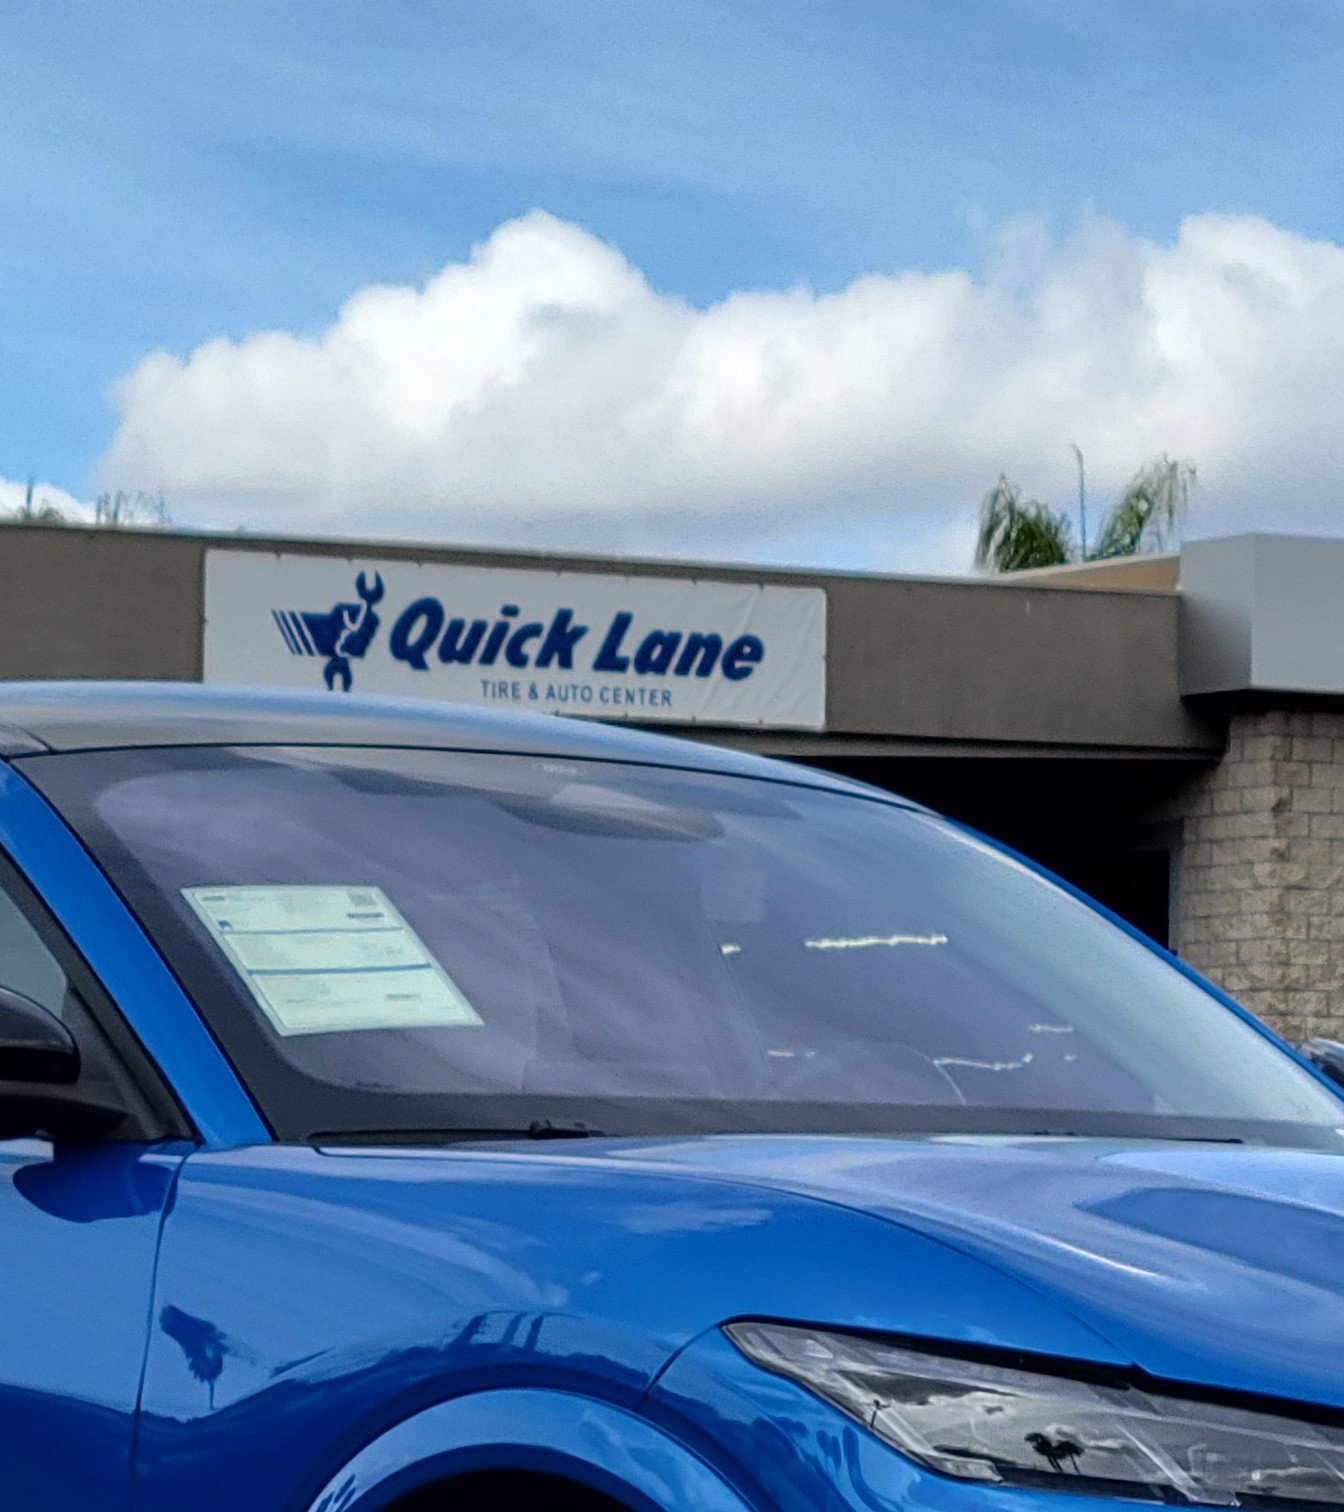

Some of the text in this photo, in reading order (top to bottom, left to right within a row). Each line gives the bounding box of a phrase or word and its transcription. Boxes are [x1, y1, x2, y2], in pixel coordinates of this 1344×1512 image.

[388, 596, 765, 682] Quick Lane
[480, 679, 673, 708] TIRE & AUTO CENTER
